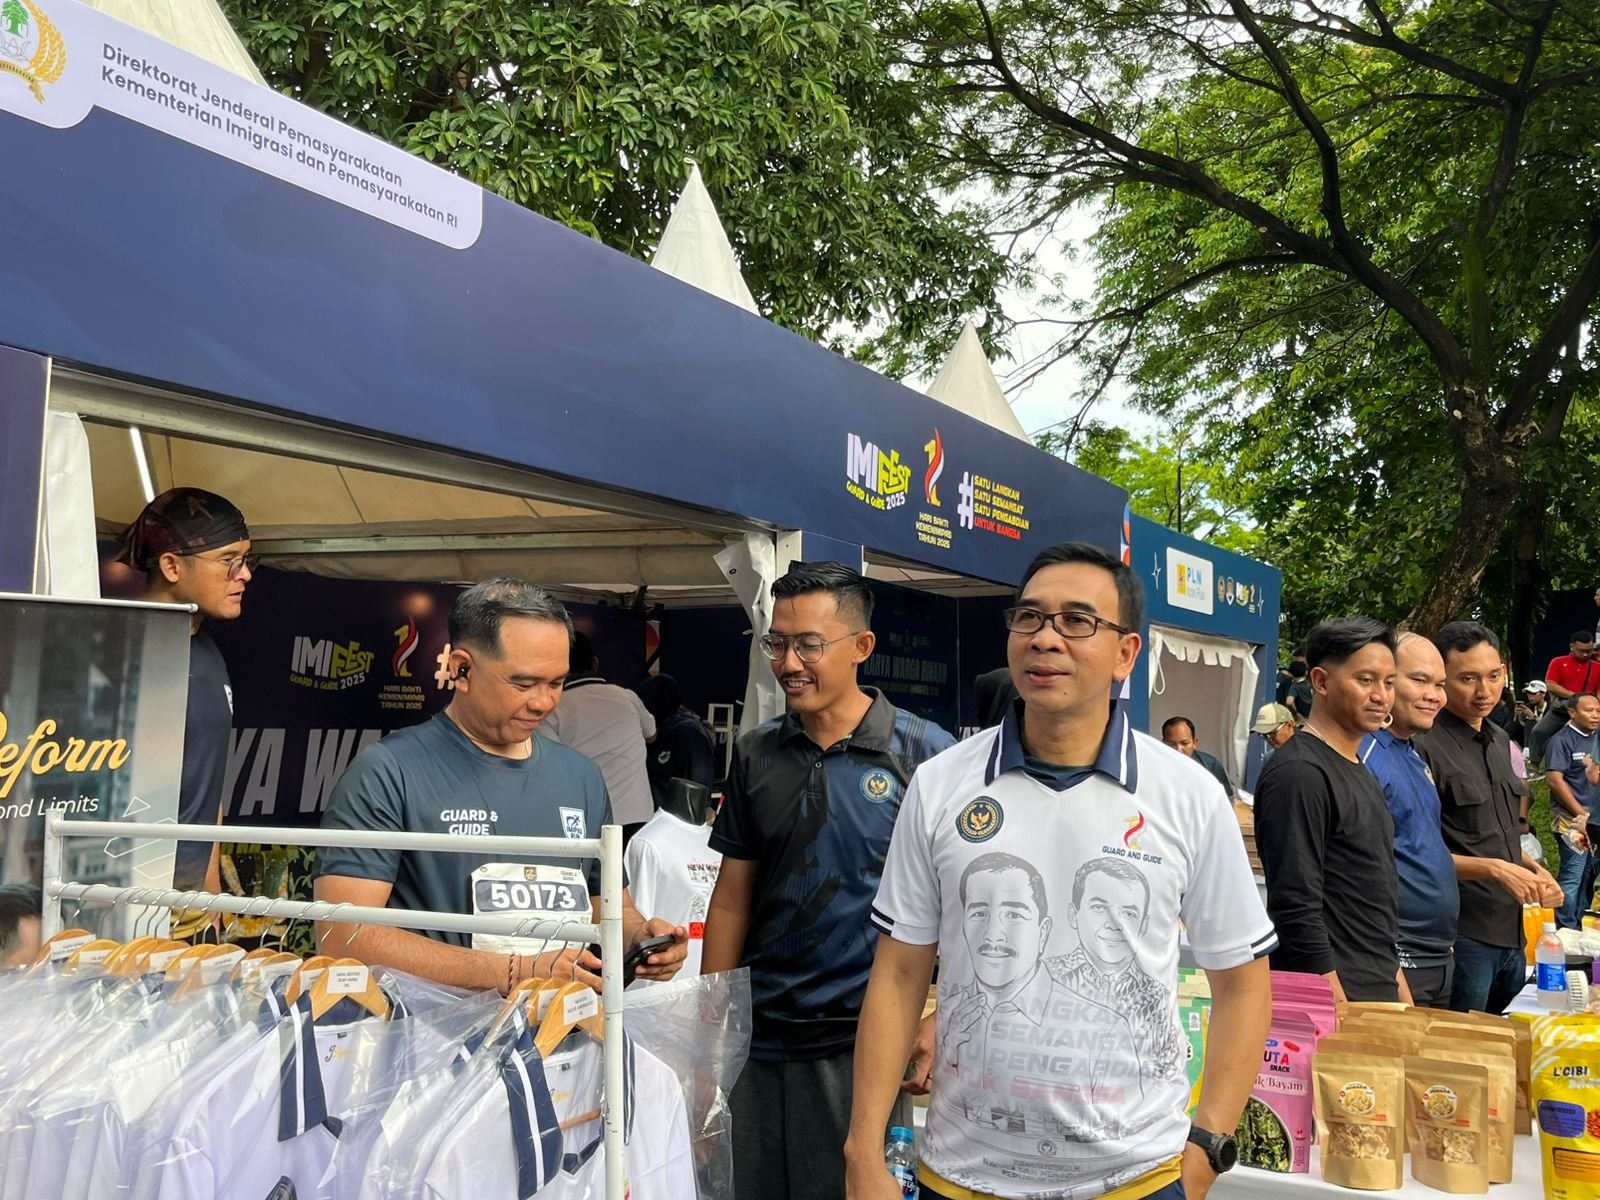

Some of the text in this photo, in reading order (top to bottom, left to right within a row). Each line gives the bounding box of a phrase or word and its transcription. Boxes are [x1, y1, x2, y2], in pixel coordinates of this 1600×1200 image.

[102, 43, 402, 187] Direktorat Jenderal Pemasyarakatan
[101, 65, 458, 229] Kementerian Imigrasi dan Pemasyarakatan RI
[974, 475, 1020, 501] SATU LANGKAH
[886, 491, 906, 510] 2025
[974, 489, 1024, 515] SATU SEMANGAT
[974, 502, 991, 517] SATU
[974, 516, 1021, 540] UNTUK BANGSA
[340, 671, 366, 689] 2025
[0, 710, 131, 798] eform
[0, 795, 100, 819] ond Limits
[440, 809, 499, 822] GUARD &
[449, 823, 490, 835] GUIDE
[1102, 845, 1162, 865] GUARD AND GUIDE
[491, 883, 576, 909] 50173
[988, 1048, 1152, 1081] PENGABDIA
[1264, 1050, 1289, 1066] UTA
[1270, 1065, 1290, 1073] SNACK
[1268, 1077, 1303, 1091] Bayam
